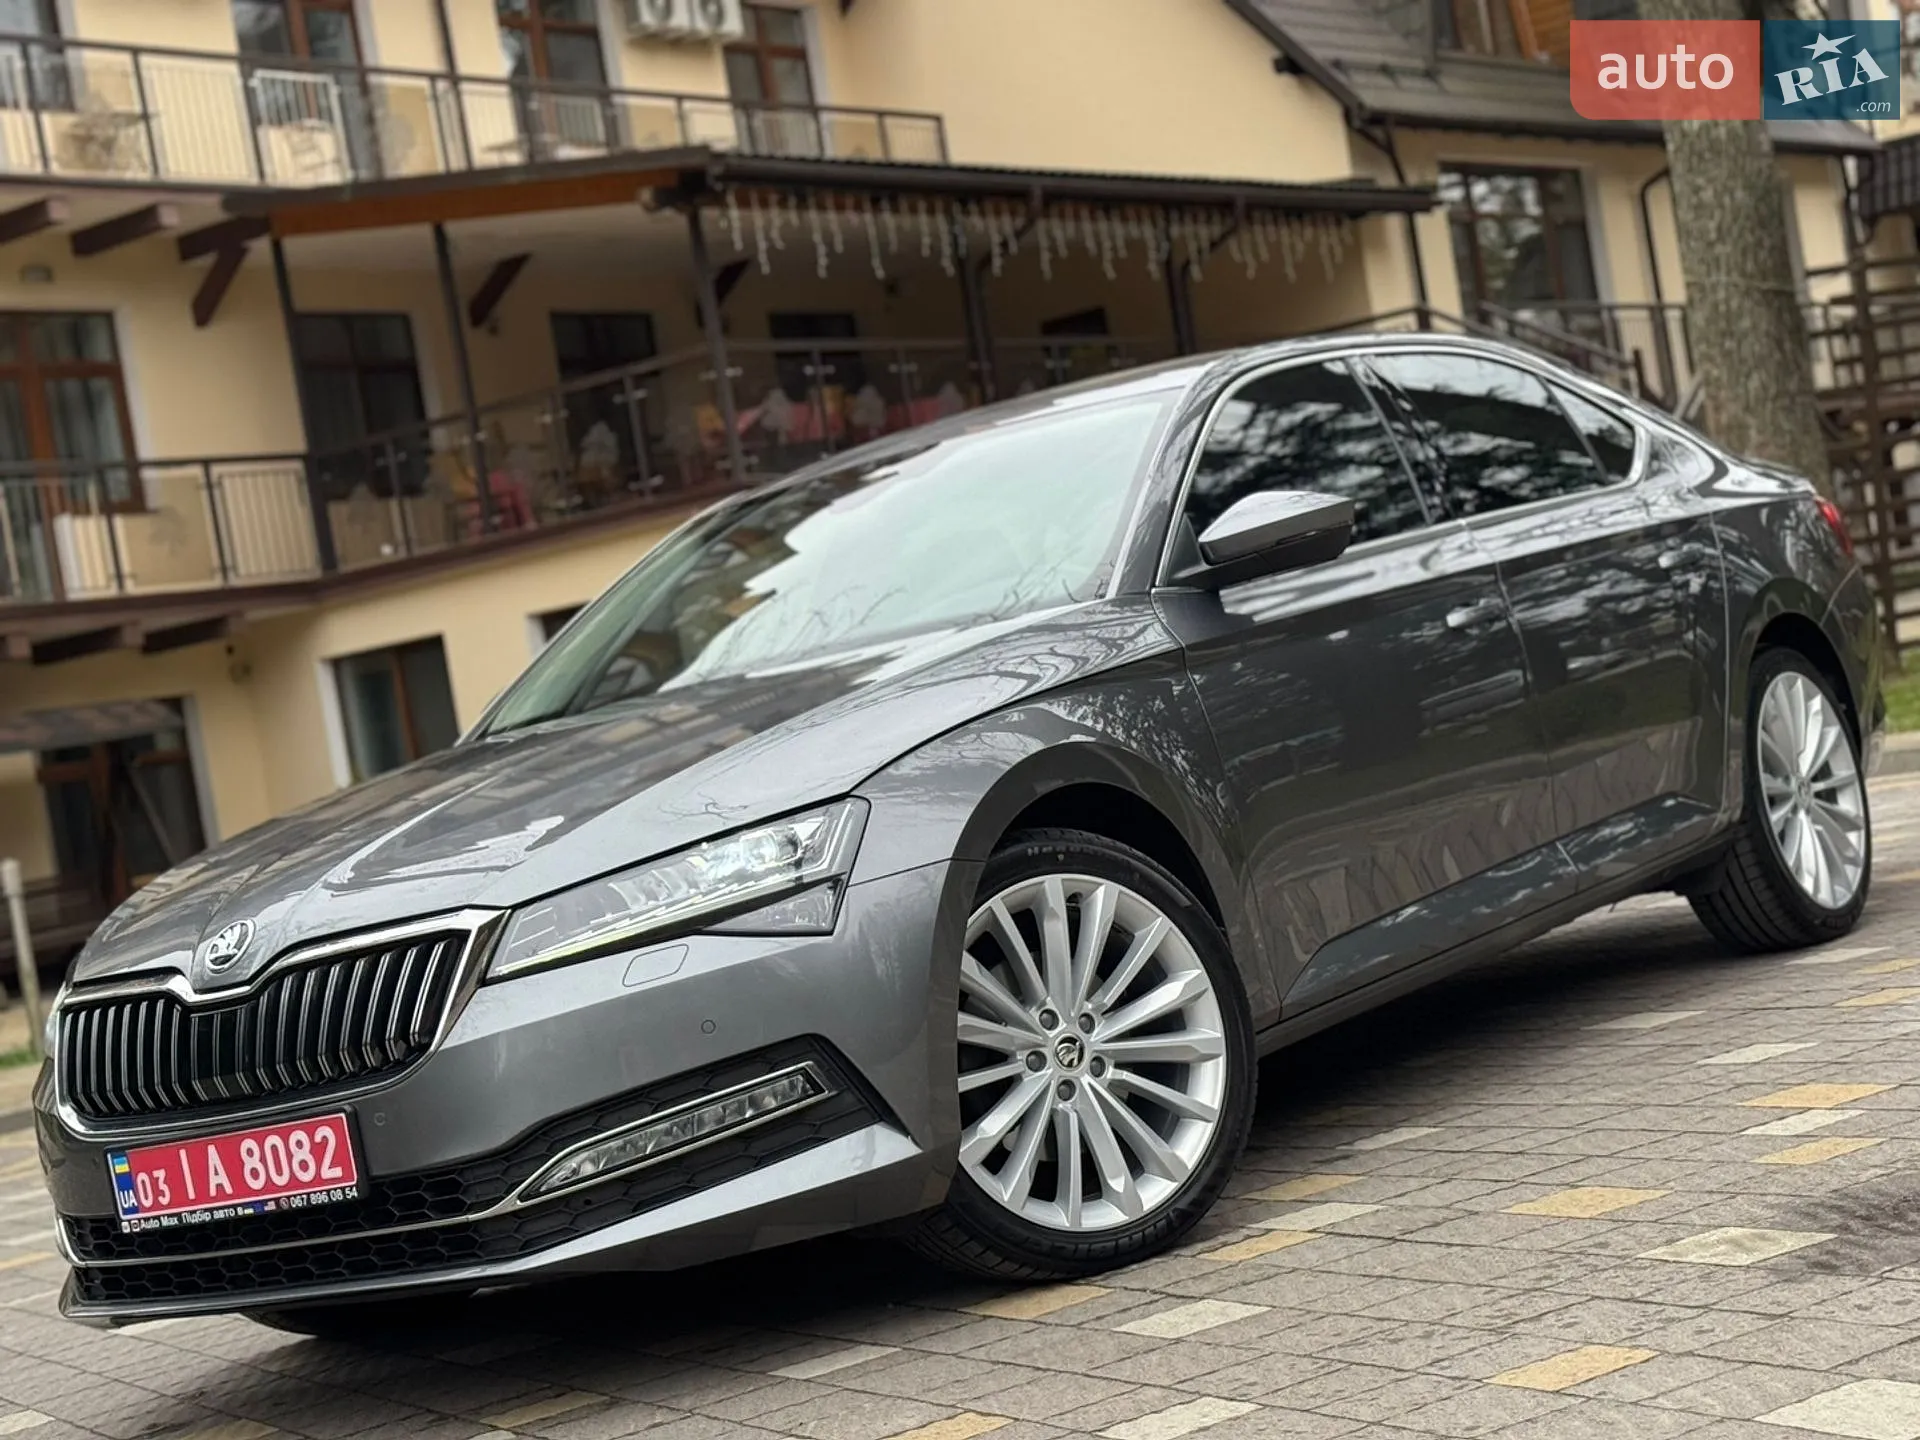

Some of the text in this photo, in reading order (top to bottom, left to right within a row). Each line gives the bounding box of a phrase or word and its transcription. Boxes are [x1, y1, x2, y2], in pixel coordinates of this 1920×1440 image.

[136, 1125, 343, 1208] 03 IA 8082
[120, 1189, 138, 1208] UA
[139, 1218, 160, 1230] Auto
[161, 1216, 179, 1226] Max
[213, 1207, 235, 1219] авто
[290, 1195, 307, 1208] 067
[310, 1192, 329, 1205] 896
[330, 1189, 343, 1201] 08
[345, 1186, 358, 1199] 54
